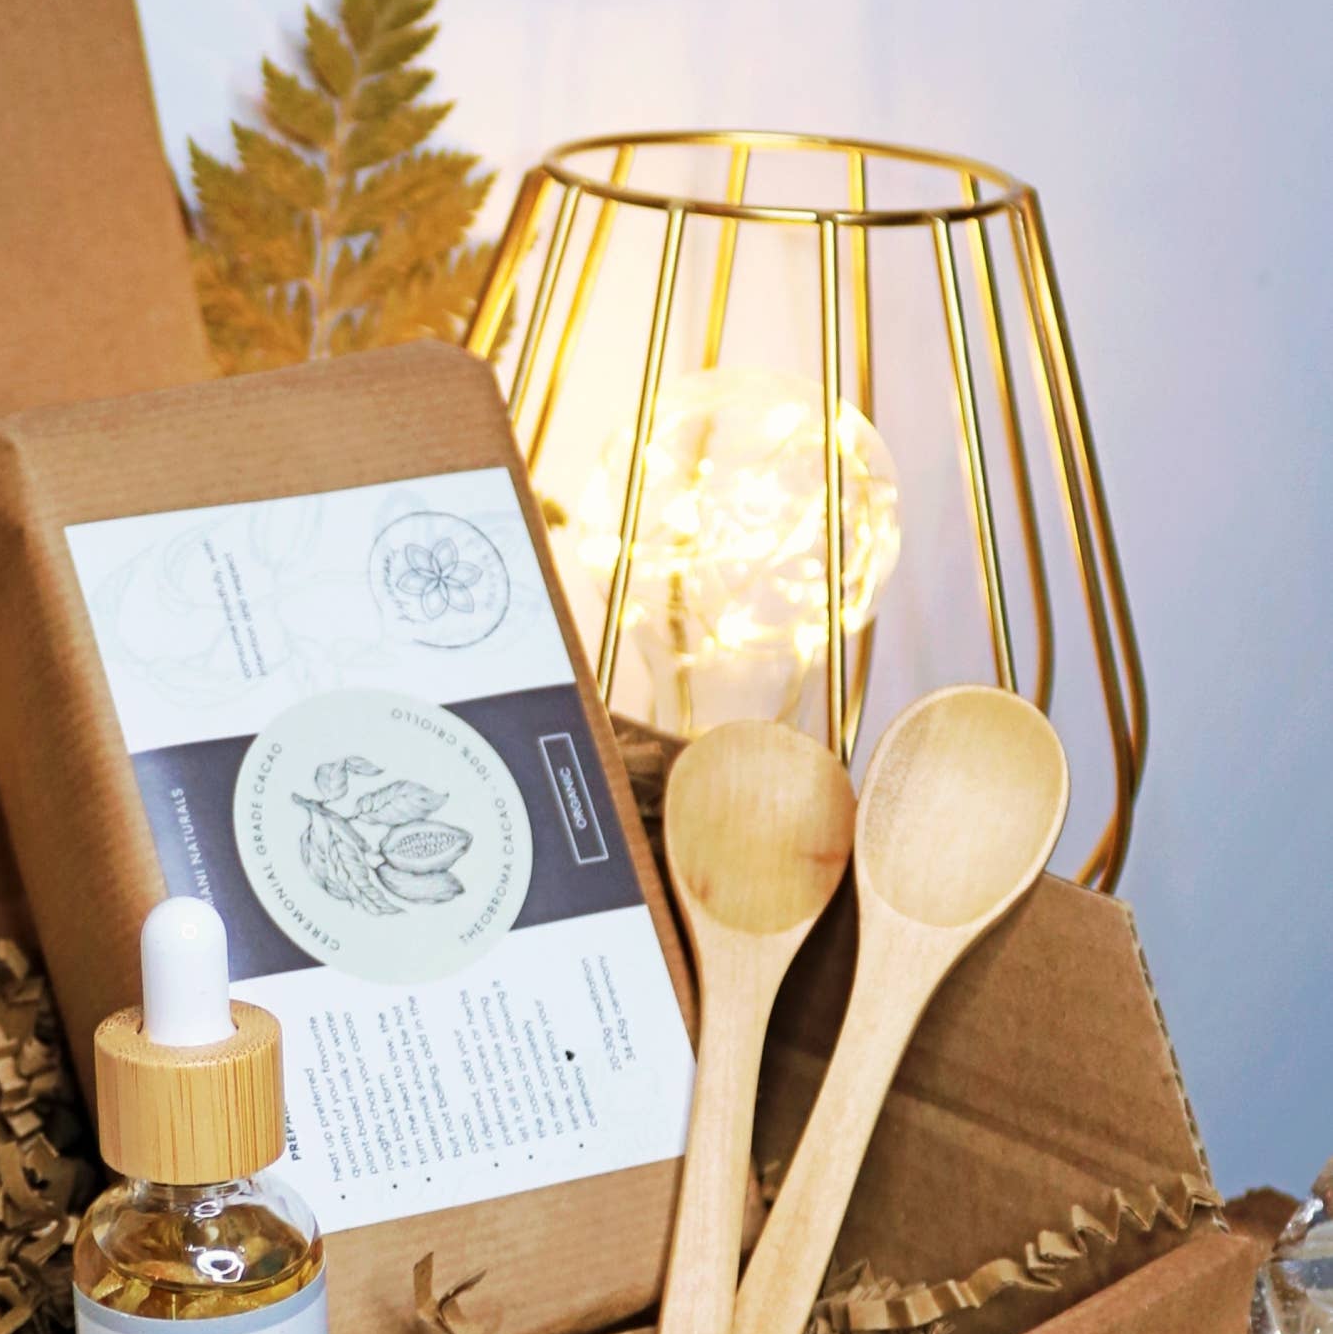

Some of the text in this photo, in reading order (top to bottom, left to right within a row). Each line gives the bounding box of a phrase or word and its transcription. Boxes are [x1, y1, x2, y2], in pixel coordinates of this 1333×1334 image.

[391, 708, 457, 745] CRIOLLO
[461, 747, 490, 781] 100%
[171, 788, 202, 865] NATURALS
[494, 797, 515, 856] CACAO
[560, 767, 587, 829] ORGANIC
[250, 743, 340, 950] CEREMONIAL GRADE CACAO
[459, 864, 512, 942] THEOBROMA
[304, 1068, 343, 1183] heat up preferred
[309, 1016, 361, 1178] quantity of your favourite
[324, 1010, 379, 1174] plant-based milk or water
[342, 1011, 395, 1172] roughly chop your cacao
[378, 1073, 411, 1168] if in block form
